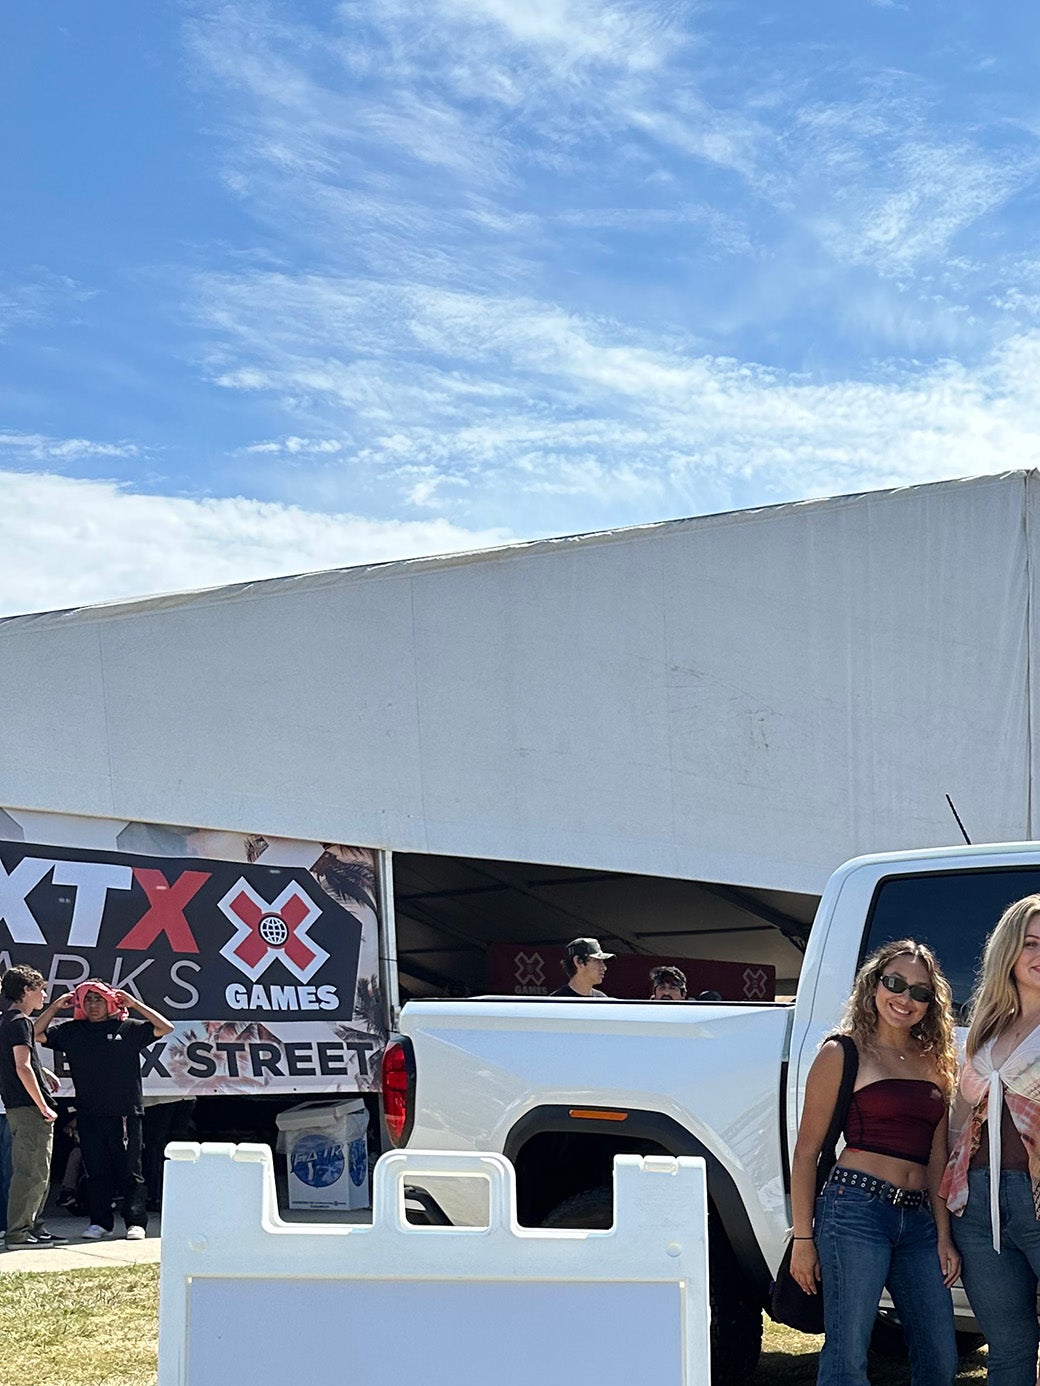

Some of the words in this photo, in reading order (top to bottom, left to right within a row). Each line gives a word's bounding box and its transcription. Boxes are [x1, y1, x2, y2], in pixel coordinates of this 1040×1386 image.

[0, 950, 201, 1010] RKS
[225, 982, 340, 1011] GAMES
[514, 985, 548, 995] GAMES
[186, 1041, 374, 1079] STREET
